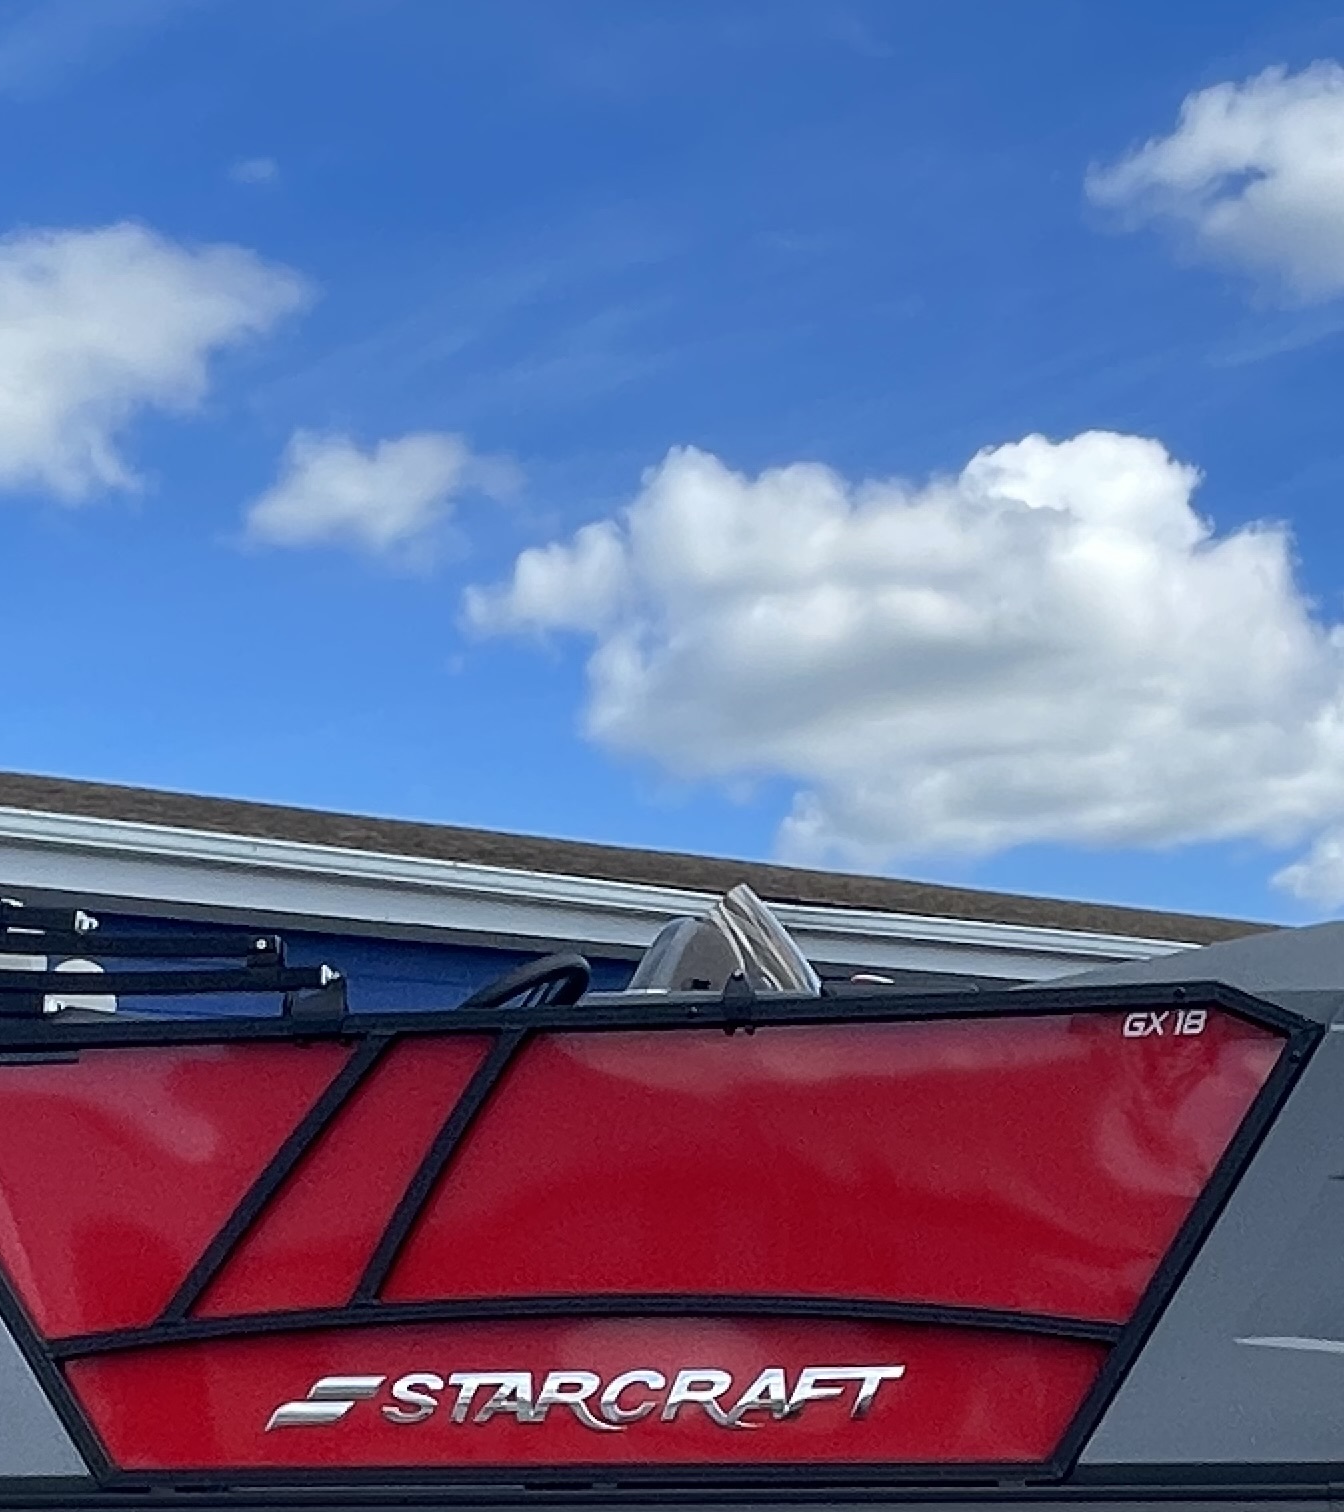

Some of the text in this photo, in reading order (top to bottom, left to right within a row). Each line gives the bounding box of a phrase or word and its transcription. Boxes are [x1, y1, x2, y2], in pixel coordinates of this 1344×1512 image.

[1123, 1009, 1207, 1037] GX 18
[381, 1364, 906, 1433] STARCRAFT
